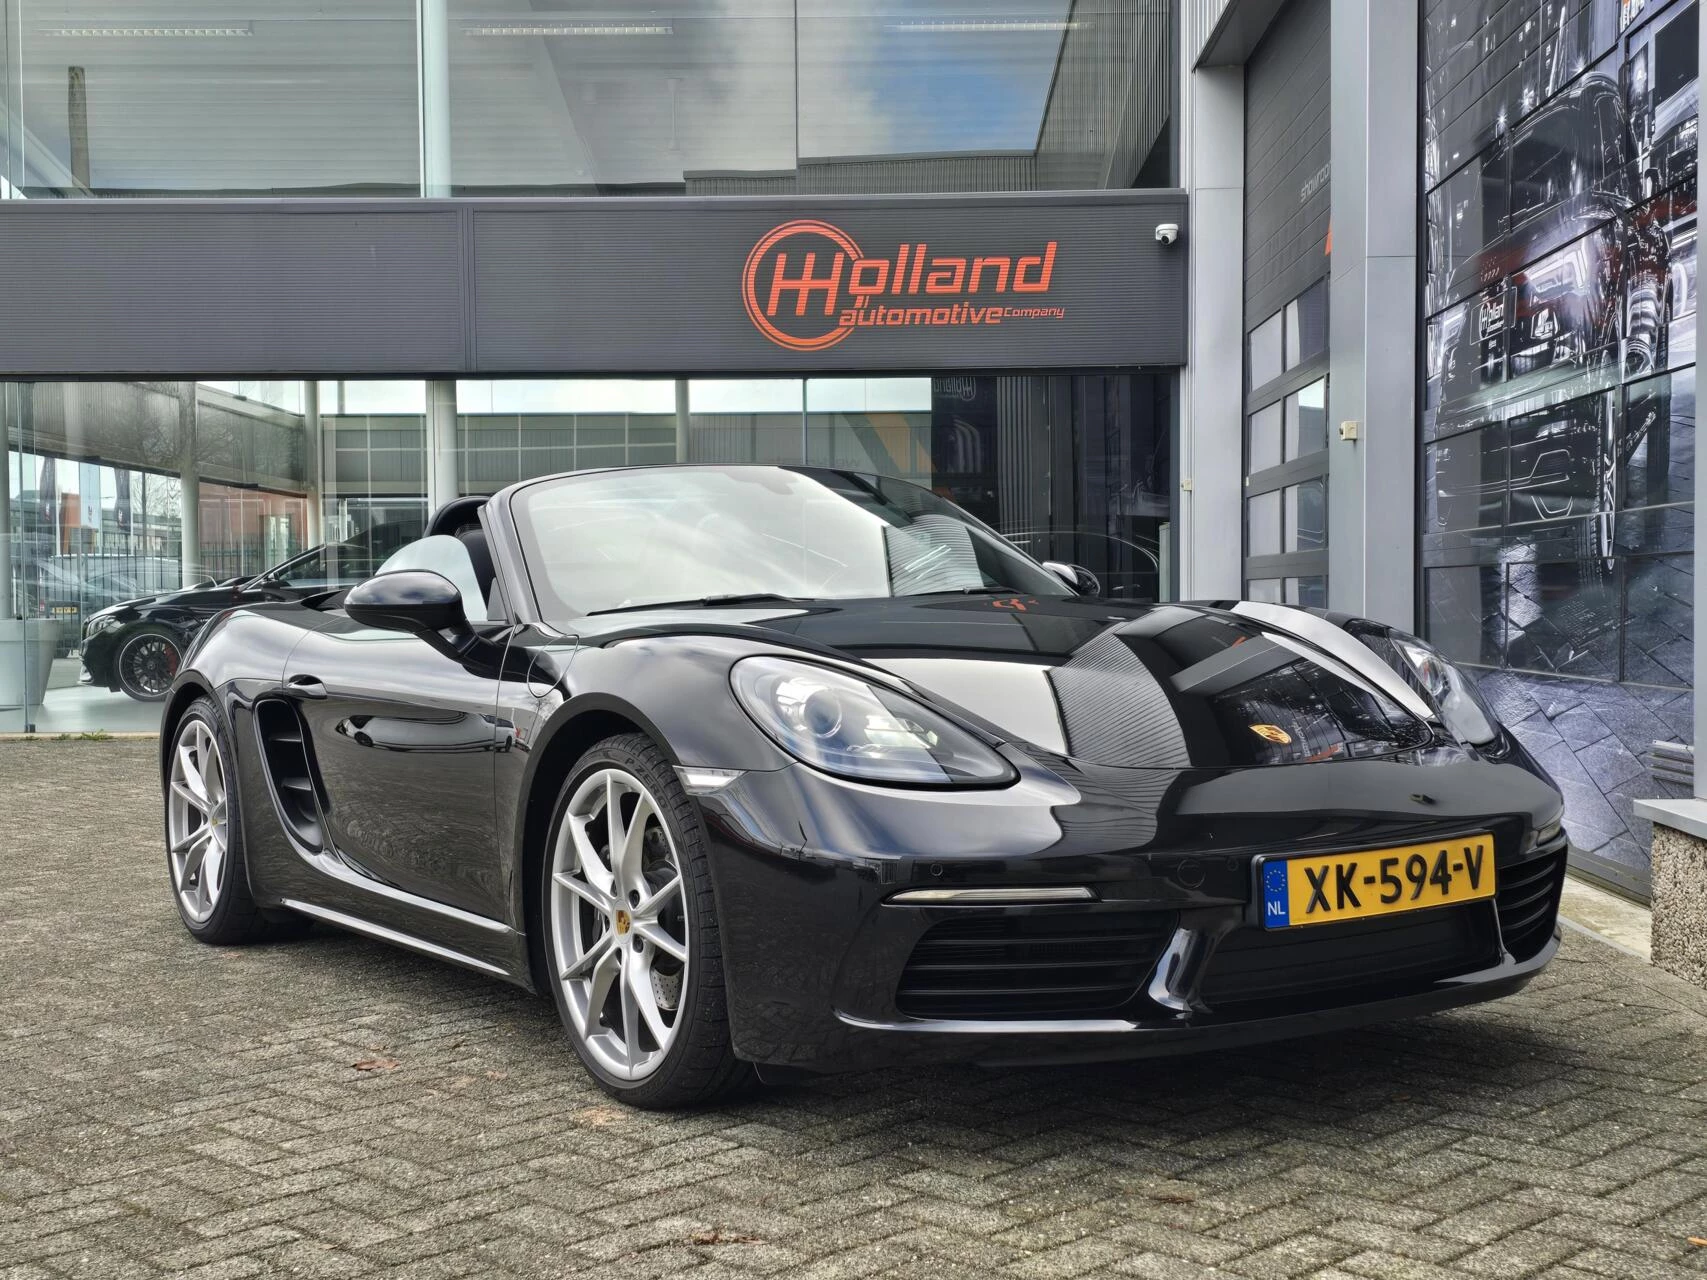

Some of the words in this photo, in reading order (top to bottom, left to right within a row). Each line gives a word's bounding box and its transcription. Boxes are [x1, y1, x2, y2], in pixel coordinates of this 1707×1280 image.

[839, 302, 1003, 326] automotive
[1003, 307, 1064, 320] Company
[1304, 845, 1484, 914] XK-594-V
[1267, 901, 1286, 916] NL
